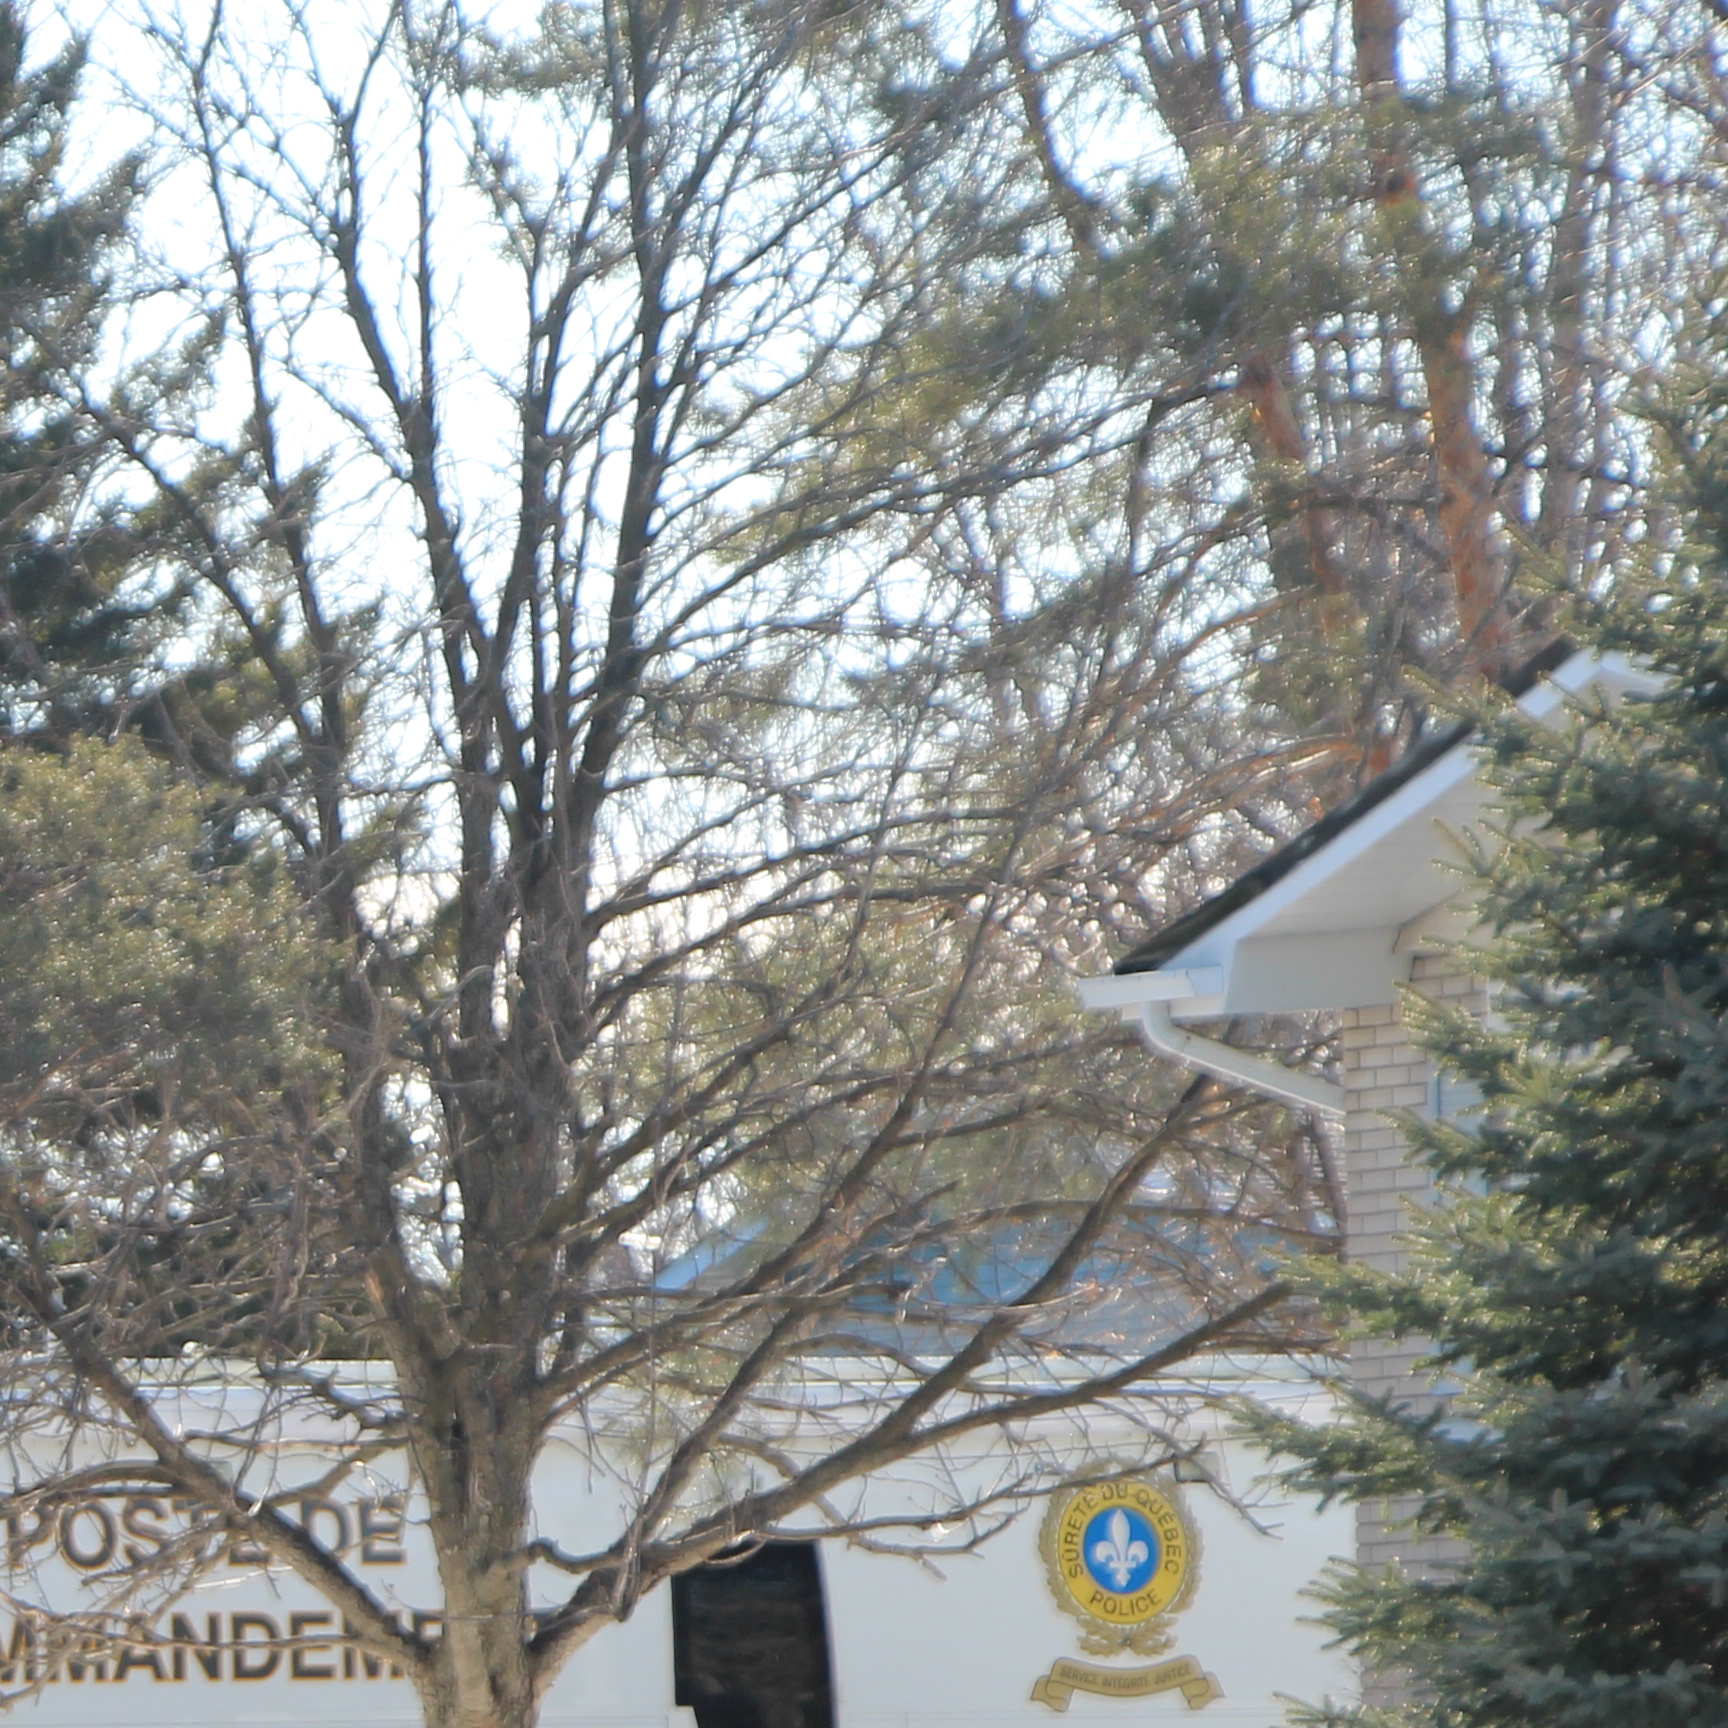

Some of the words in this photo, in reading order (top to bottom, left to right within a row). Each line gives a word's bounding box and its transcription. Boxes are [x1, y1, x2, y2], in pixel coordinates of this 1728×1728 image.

[300, 1496, 409, 1566] DE
[1101, 1482, 1129, 1501] DU
[1136, 1489, 1182, 1576] QUÉBEC
[1089, 1589, 1163, 1617] POLICE
[1060, 1664, 1097, 1686] SERVICE
[1155, 1662, 1192, 1686] JUSTICE
